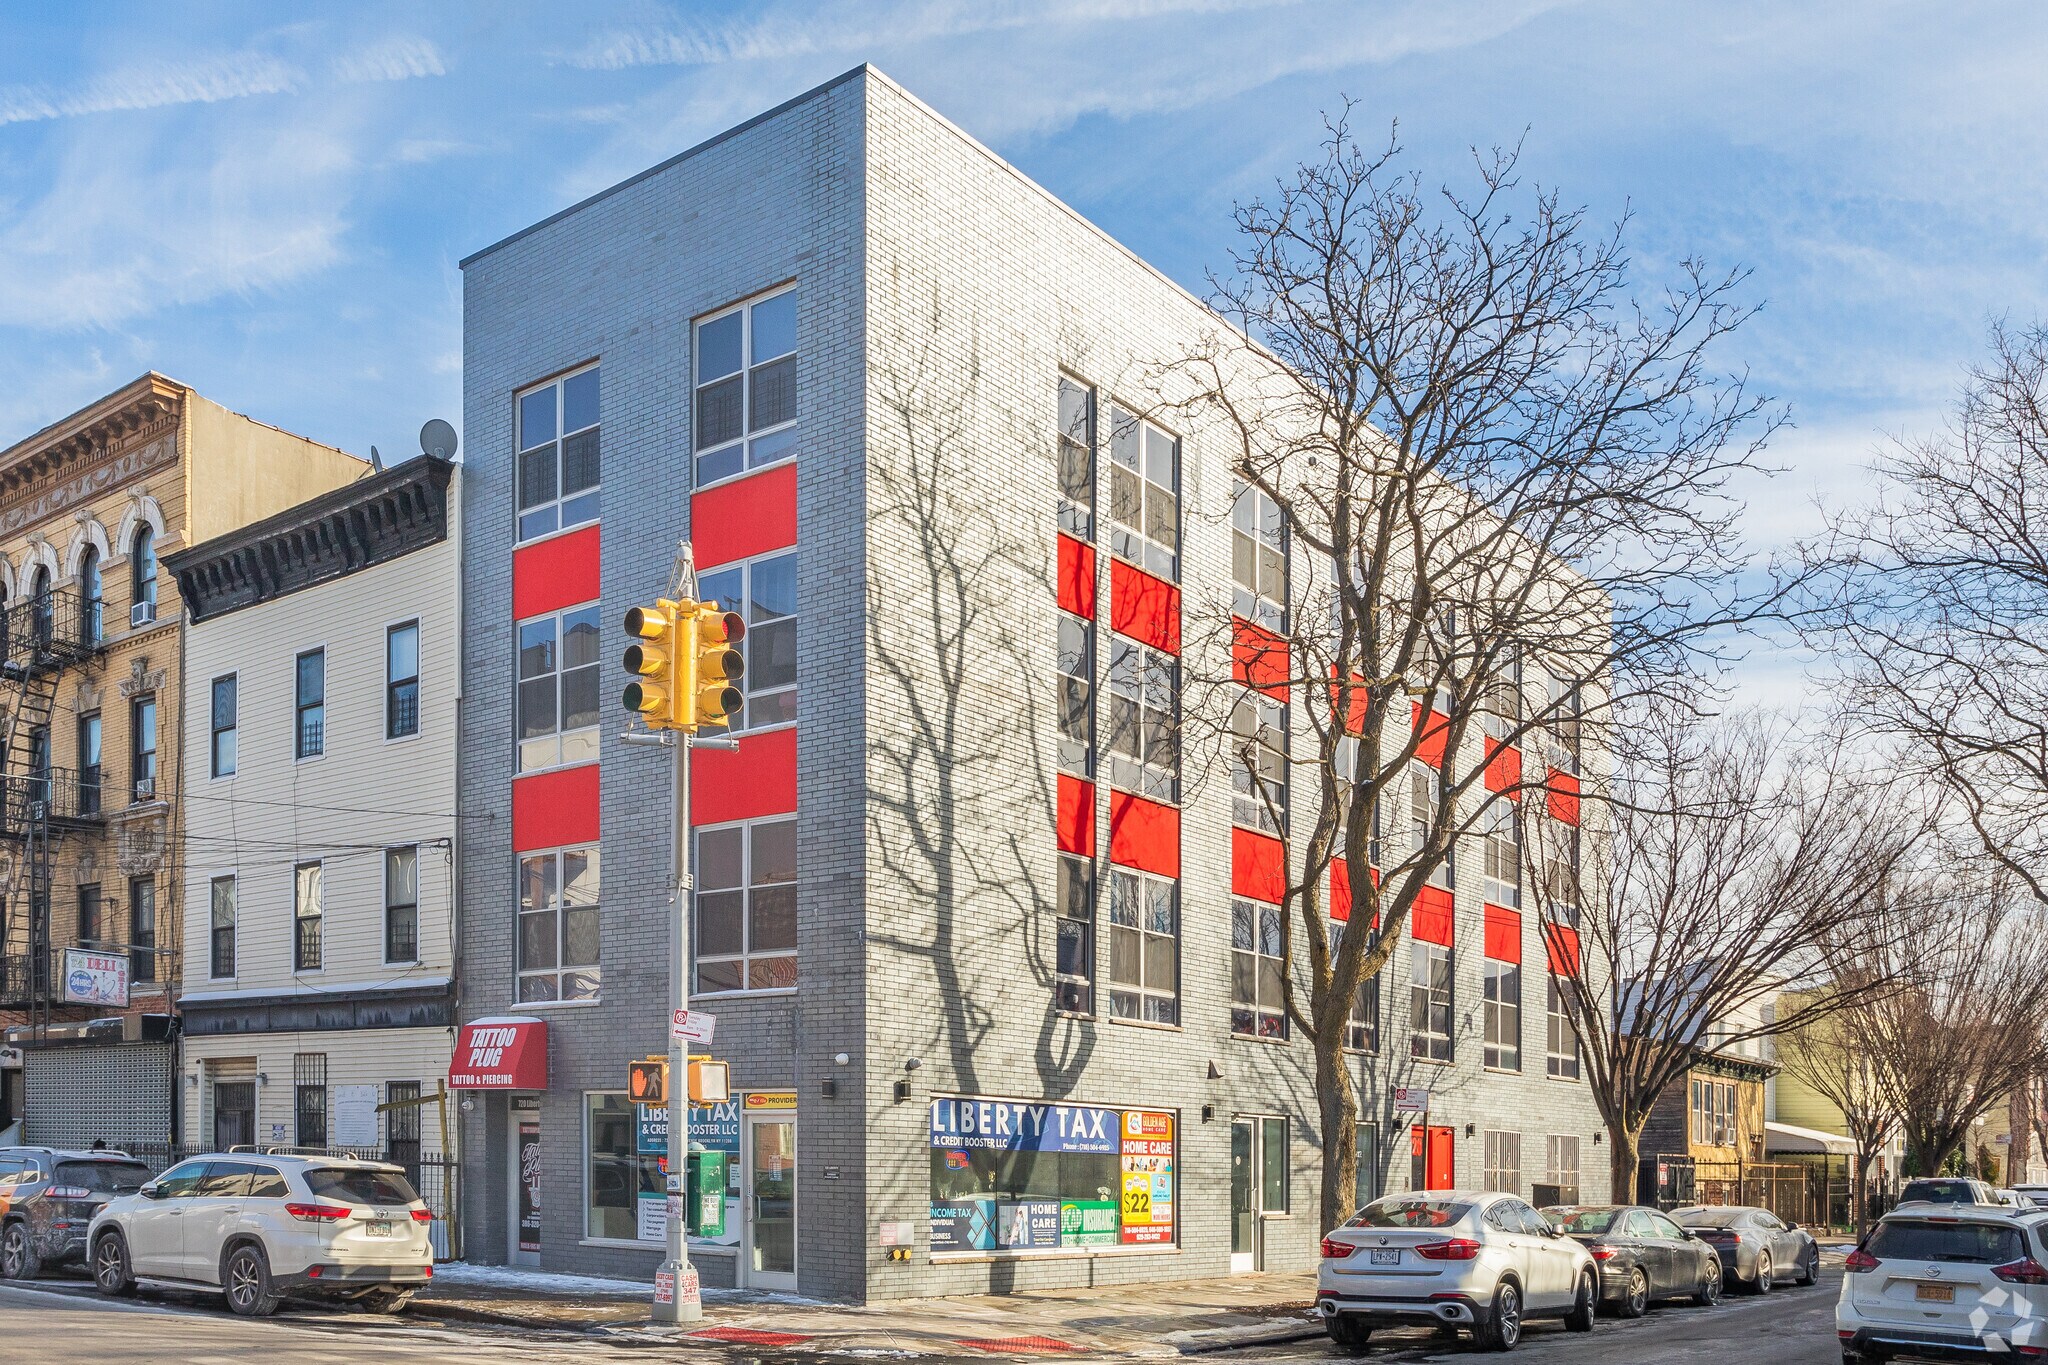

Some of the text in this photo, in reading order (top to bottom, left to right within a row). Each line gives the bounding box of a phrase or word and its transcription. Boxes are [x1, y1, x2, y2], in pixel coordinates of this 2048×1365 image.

[87, 957, 116, 972] DELI
[470, 1028, 517, 1048] TATTOO
[468, 1048, 503, 1068] PLUG
[452, 1074, 512, 1084] TATTOO & PIERCING
[527, 1099, 540, 1108] Libert
[934, 1099, 1106, 1139] LIBERTY TAX
[1143, 1116, 1159, 1127] GOLDEN
[642, 1124, 649, 1134] &
[722, 1124, 738, 1134] LLC
[934, 1136, 1008, 1148] & CREDIT BOOSTER LLC
[1123, 1140, 1172, 1154] HOME CARE
[1124, 1192, 1148, 1213] $22
[958, 1208, 972, 1218] TAX
[1031, 1204, 1057, 1214] HOME
[1032, 1218, 1056, 1228] CARE
